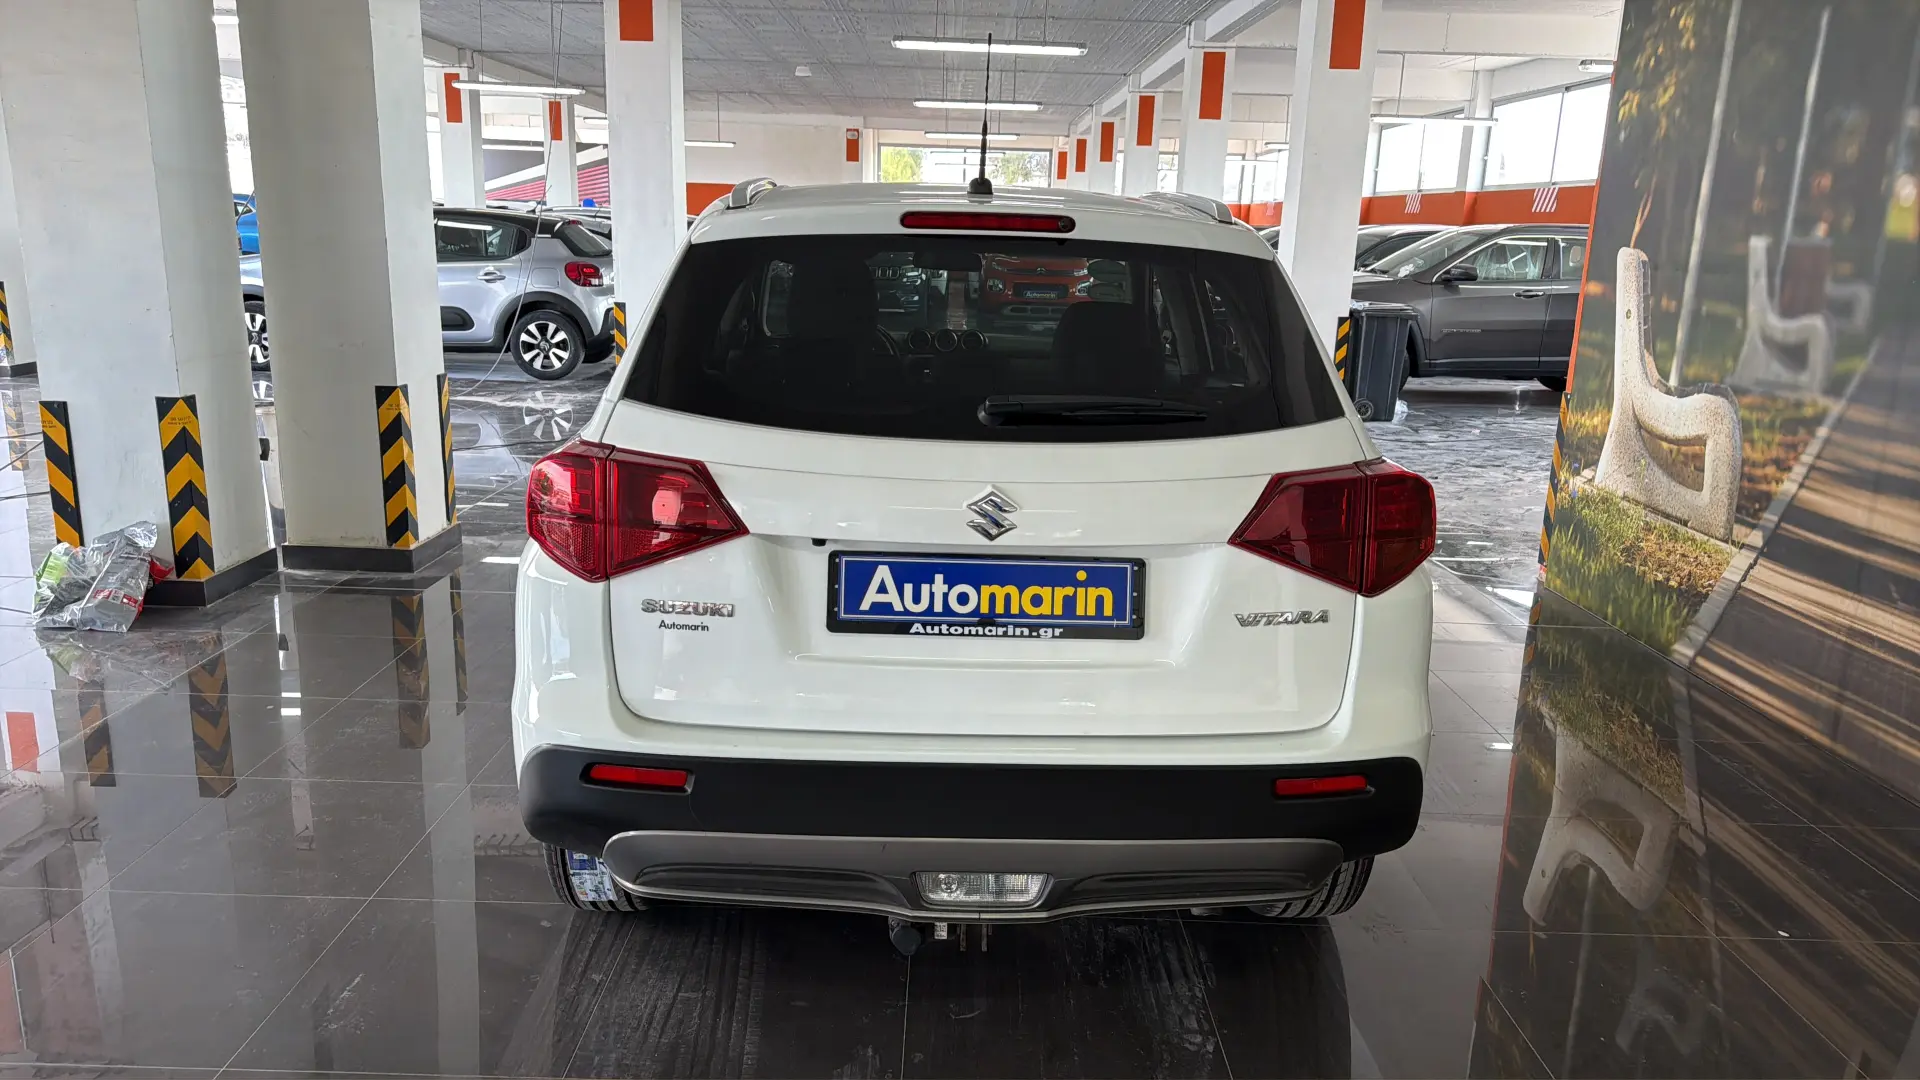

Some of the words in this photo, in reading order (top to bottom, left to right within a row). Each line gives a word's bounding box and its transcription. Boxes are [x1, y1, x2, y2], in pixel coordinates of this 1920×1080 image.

[859, 565, 1113, 617] Automarin
[641, 599, 734, 617] SUZUKI
[658, 619, 709, 632] Automarin
[1234, 609, 1329, 627] VITARA
[909, 622, 1063, 638] Automarin.gr
